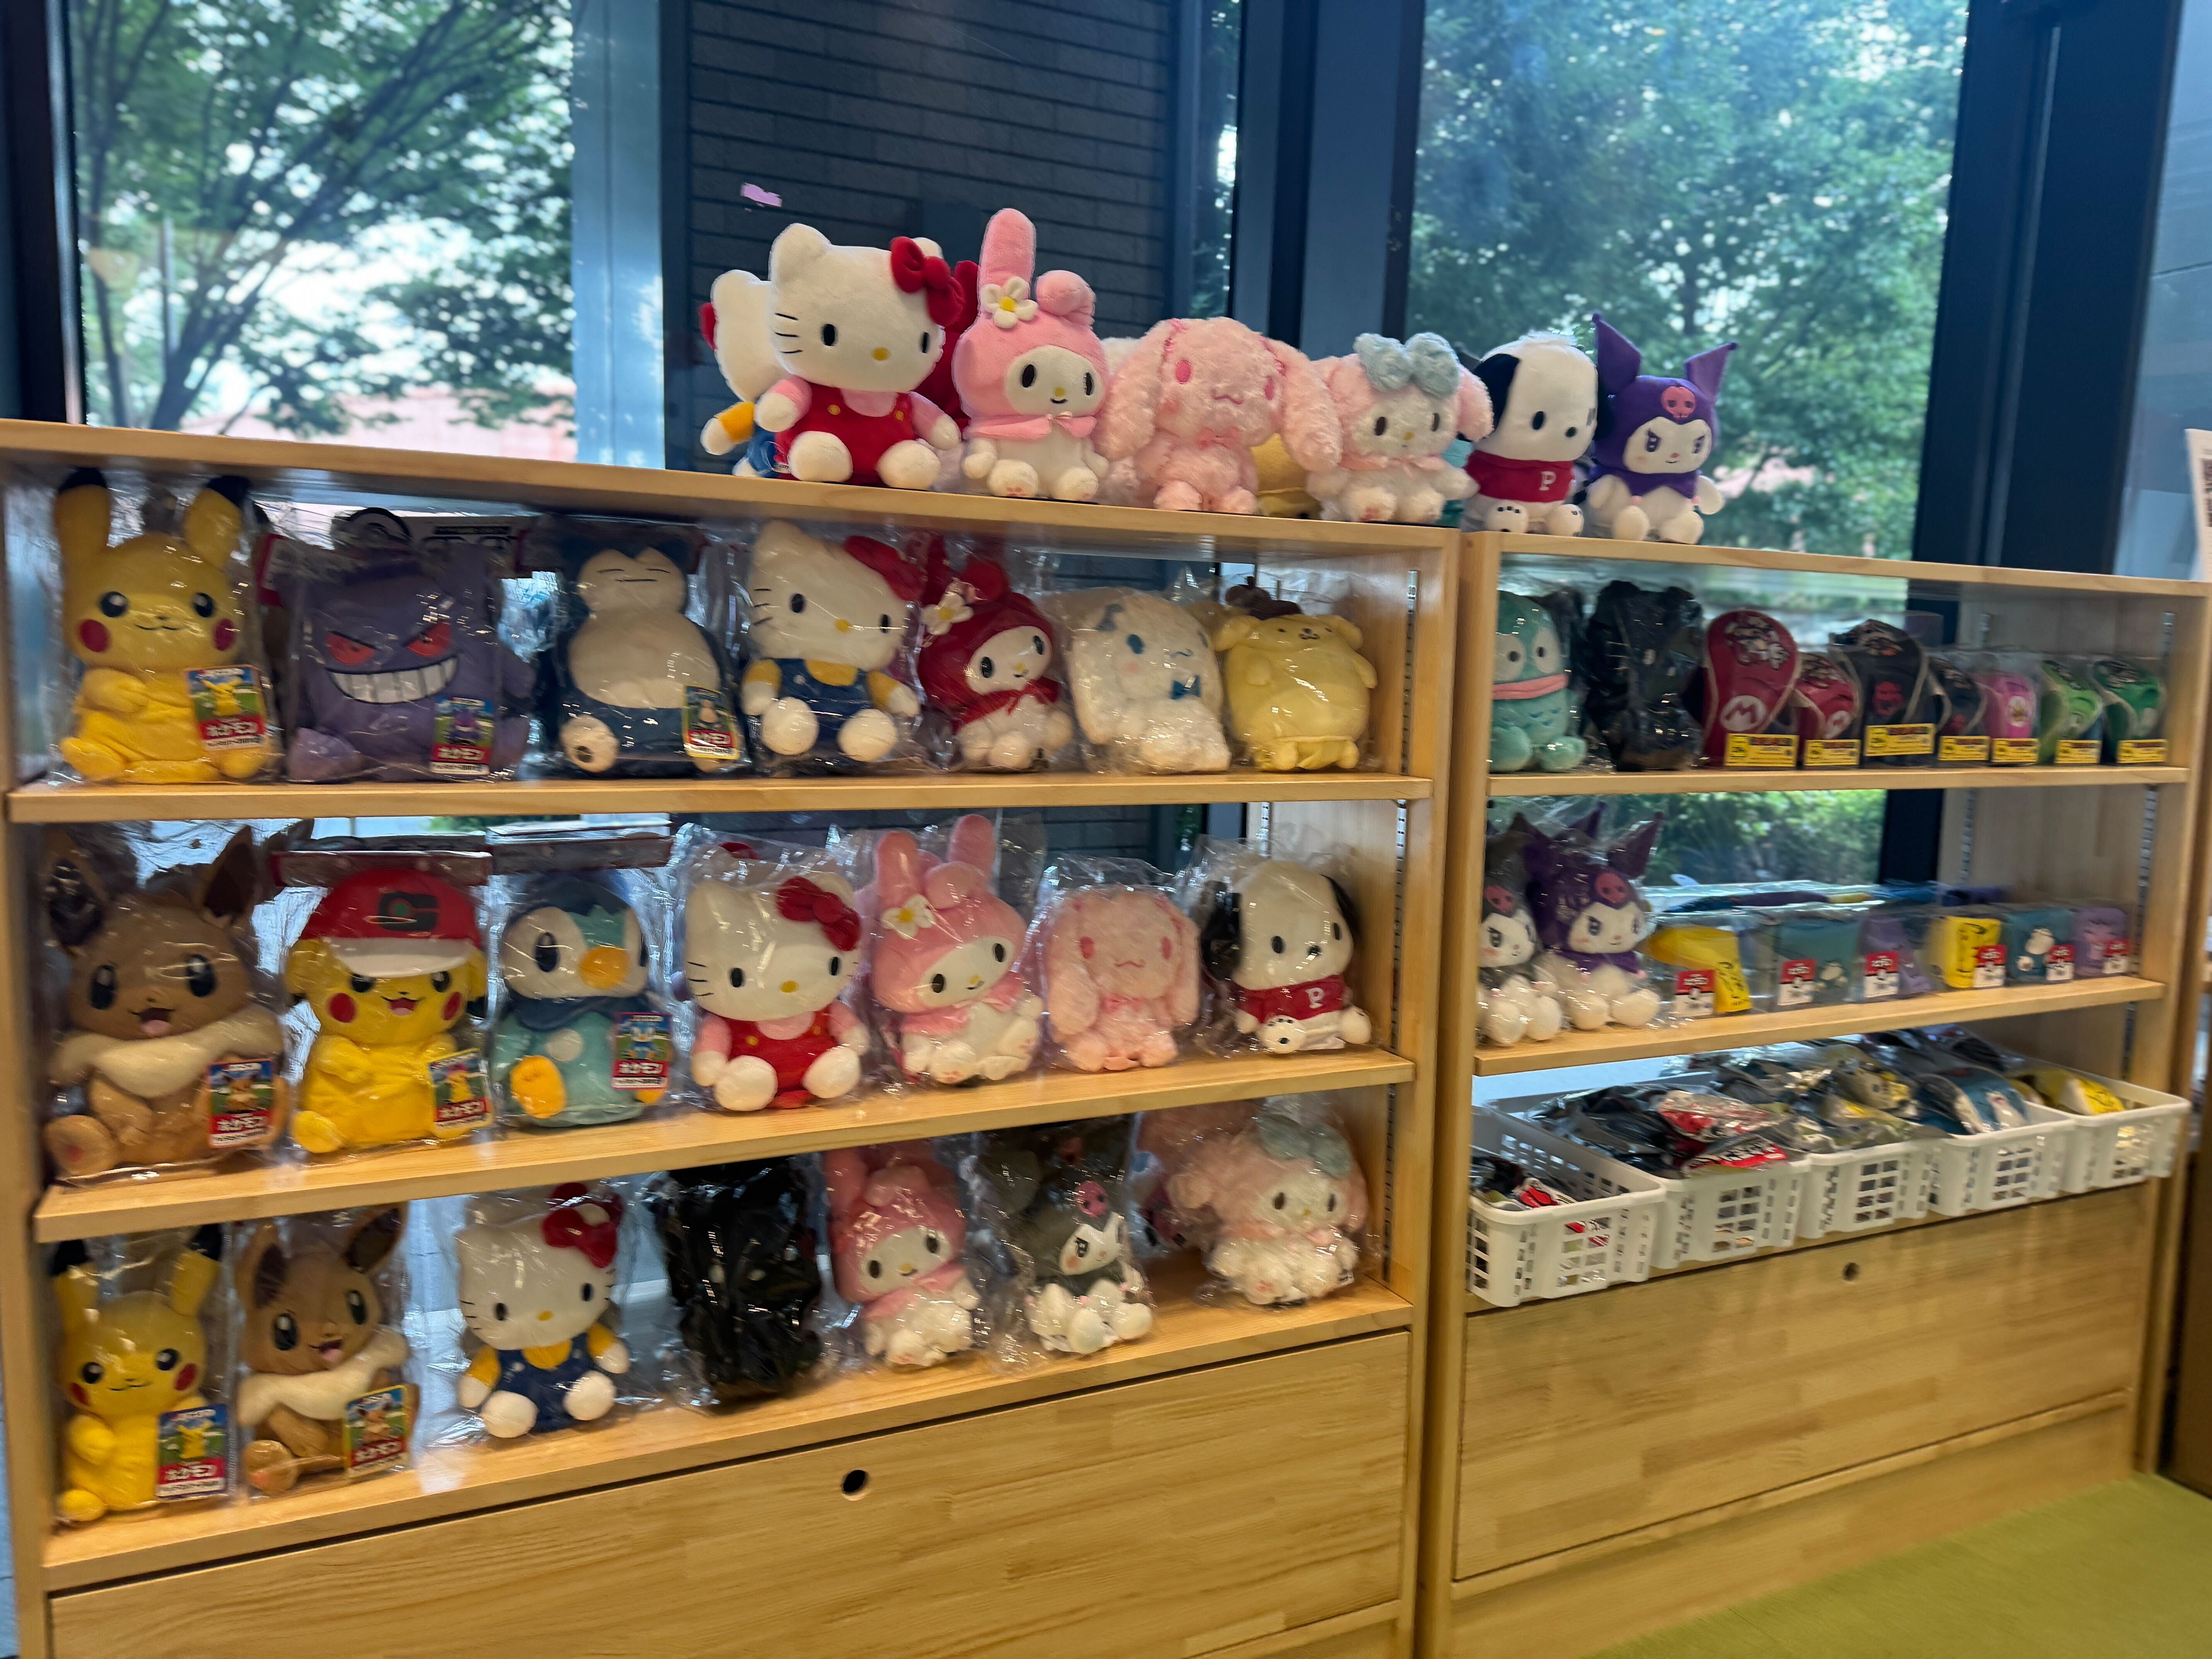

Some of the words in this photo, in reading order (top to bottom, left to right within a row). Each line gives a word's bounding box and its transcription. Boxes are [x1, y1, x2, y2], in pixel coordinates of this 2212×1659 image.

[1539, 471, 1556, 491] P
[1725, 701, 1757, 724] M
[1305, 987, 1325, 1009] P
